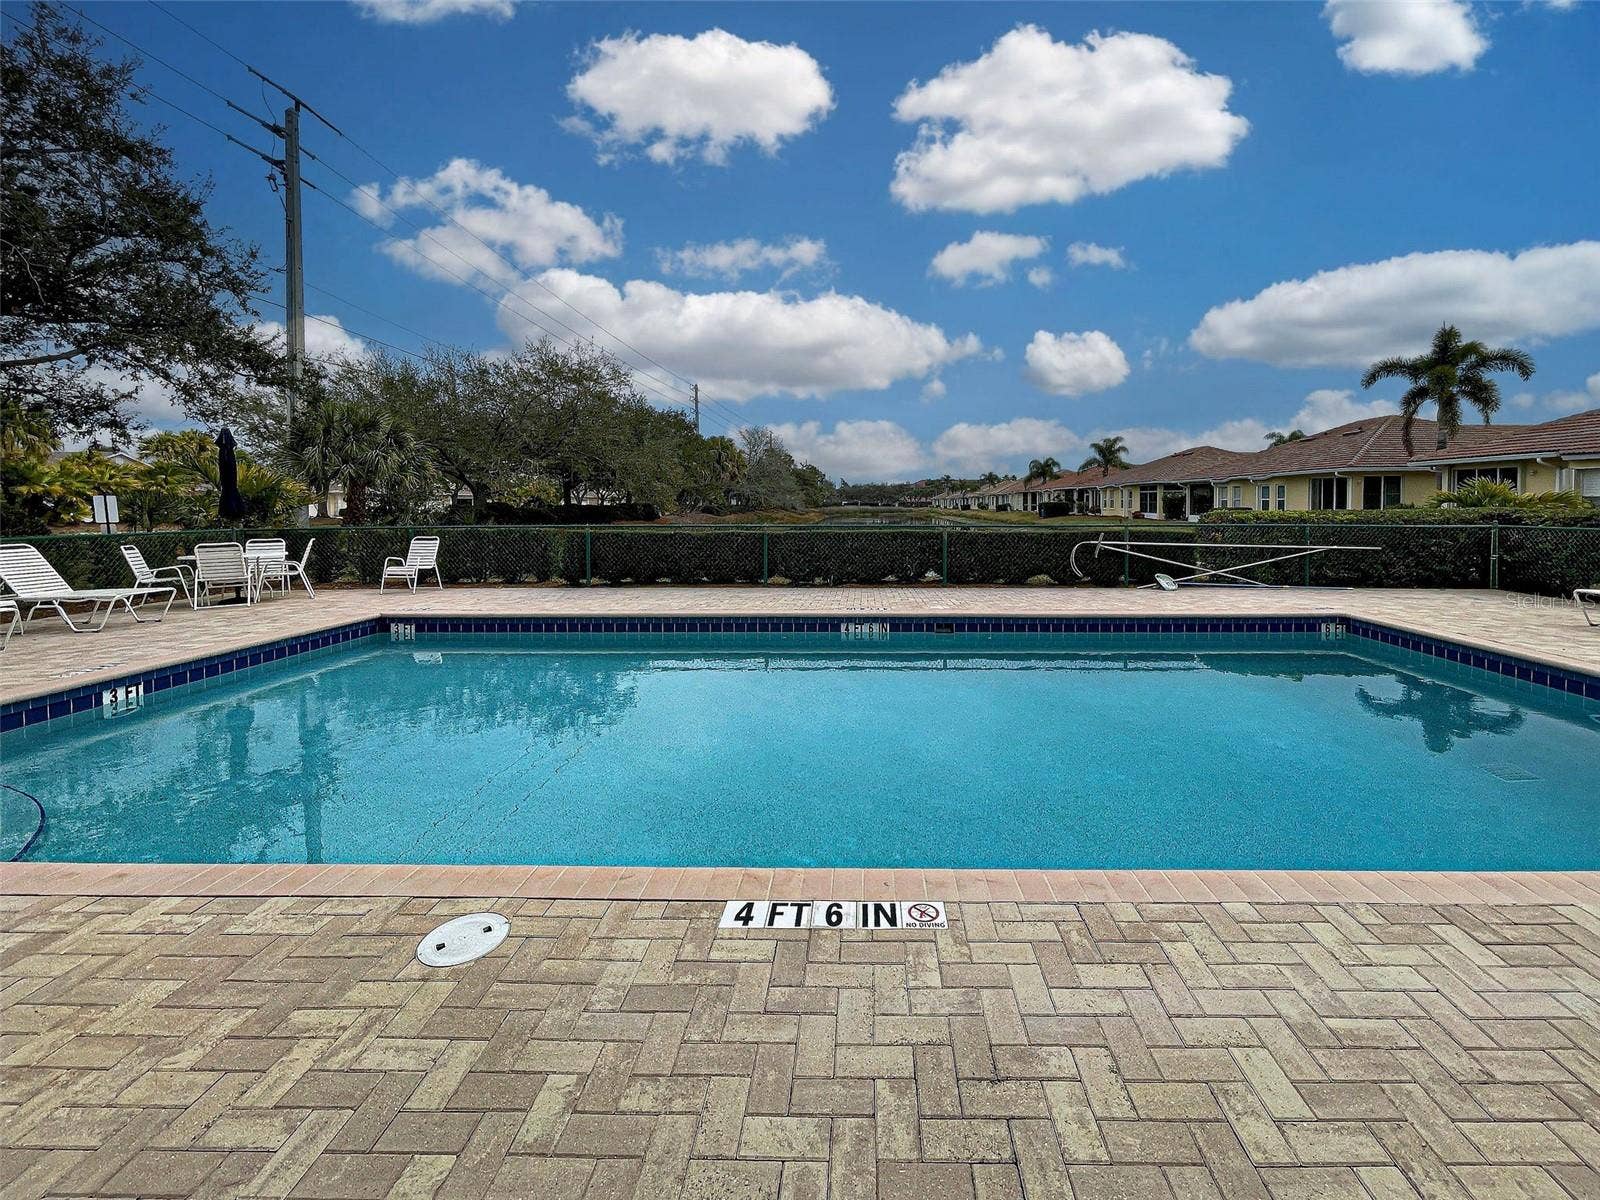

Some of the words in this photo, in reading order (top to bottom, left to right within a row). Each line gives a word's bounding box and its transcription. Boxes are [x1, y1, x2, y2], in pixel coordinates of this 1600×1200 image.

[854, 623, 864, 632] FT
[110, 688, 118, 703] 3
[125, 682, 142, 700] FT
[734, 902, 754, 927] 4
[768, 902, 811, 927] FT
[825, 903, 843, 927] 6
[862, 903, 898, 927] IN
